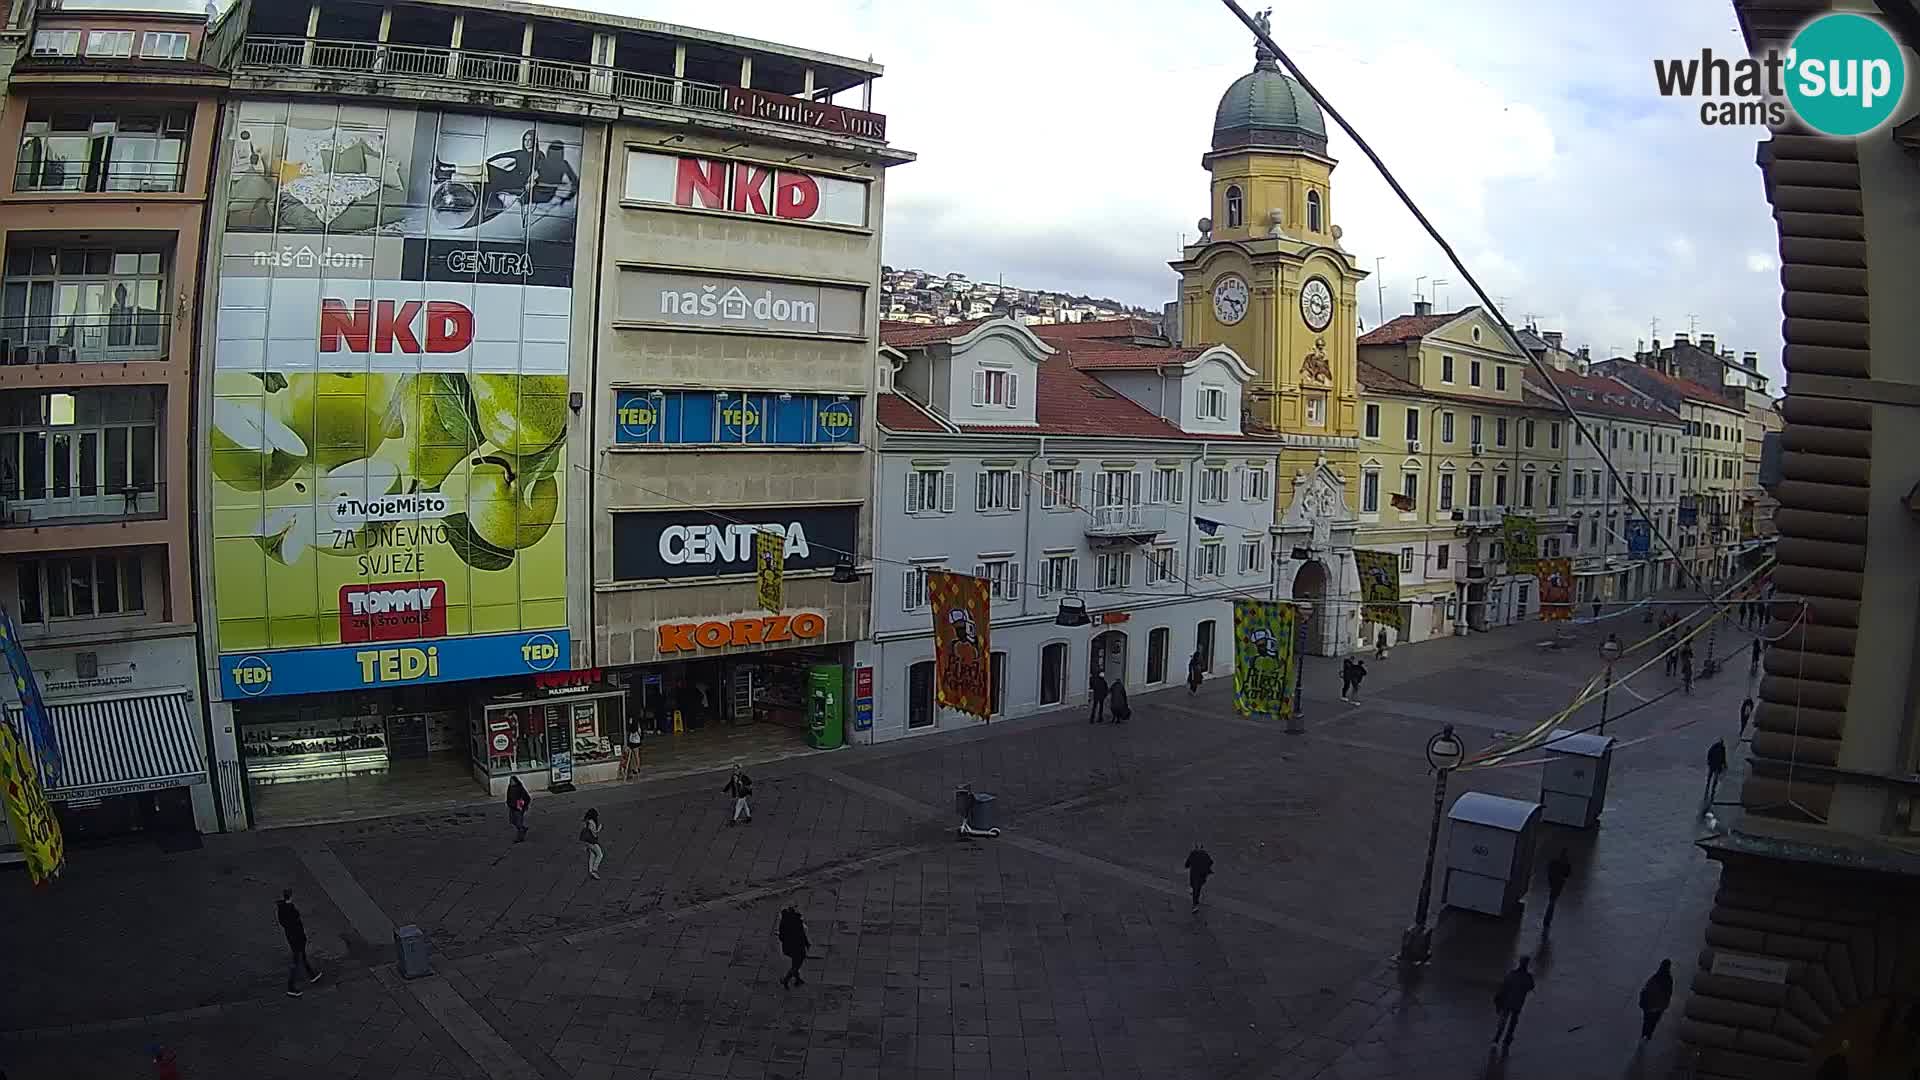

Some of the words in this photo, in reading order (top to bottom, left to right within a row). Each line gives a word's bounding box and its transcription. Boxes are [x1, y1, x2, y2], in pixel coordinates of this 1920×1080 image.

[723, 88, 745, 113] Le
[674, 155, 821, 221] NKD
[252, 245, 294, 269] naš
[318, 246, 365, 270] dom
[446, 249, 535, 277] CENTRA
[659, 284, 718, 316] naš
[753, 290, 817, 324] dom
[319, 296, 477, 354] NKD
[617, 408, 657, 426] TEDi
[722, 408, 759, 426] TEDi
[819, 411, 853, 427] TEDi
[336, 498, 446, 516] #TvojeMisto
[332, 529, 356, 551] ZA
[363, 524, 450, 549] DNEVNO
[358, 552, 425, 577] SVJEŽE
[347, 587, 438, 615] TOMMY
[658, 612, 826, 654] KORZO
[522, 643, 559, 661] TEDi
[233, 666, 272, 684] TEDi
[356, 646, 441, 684] TEDi
